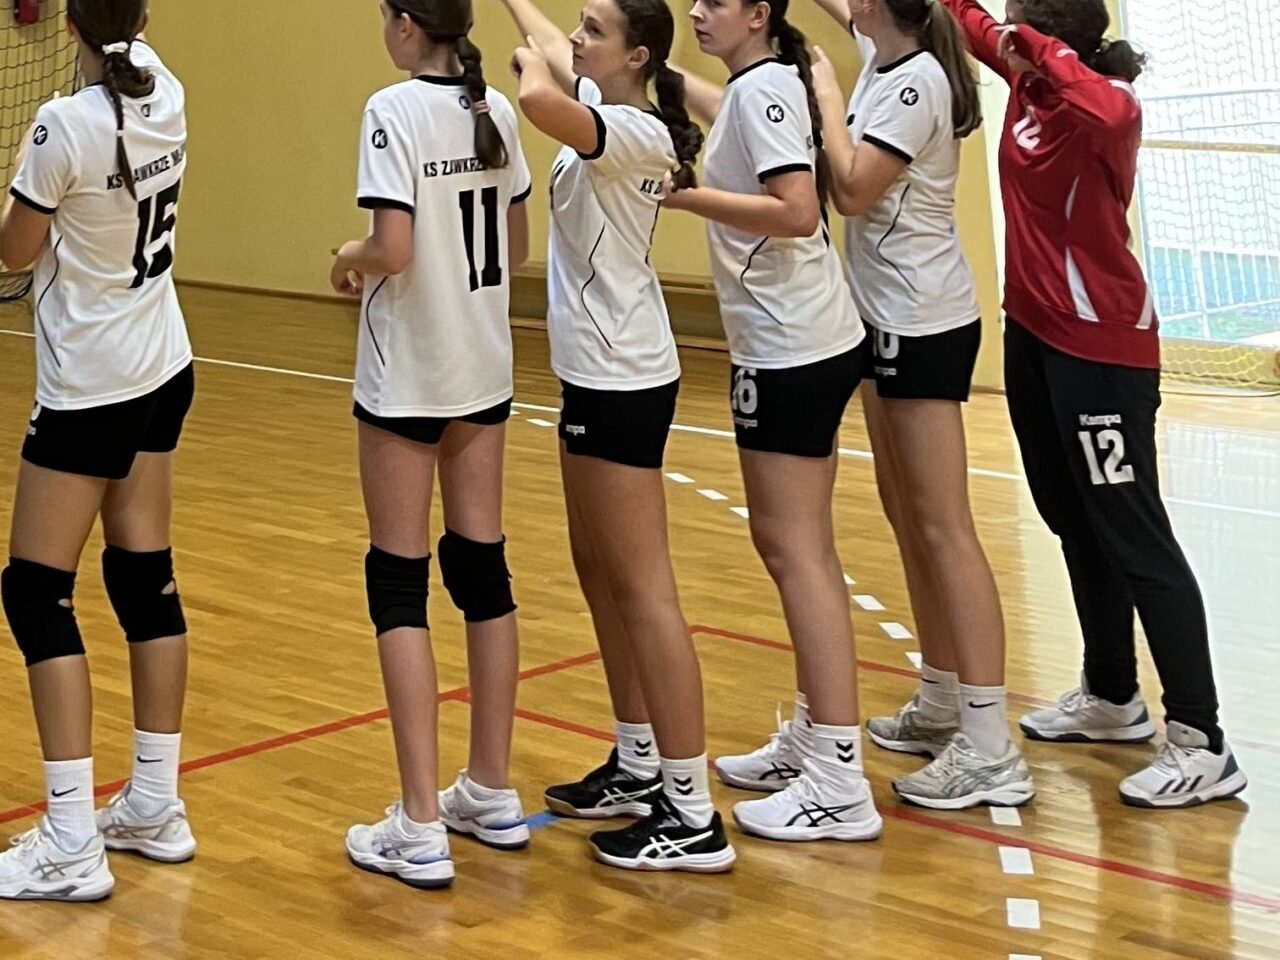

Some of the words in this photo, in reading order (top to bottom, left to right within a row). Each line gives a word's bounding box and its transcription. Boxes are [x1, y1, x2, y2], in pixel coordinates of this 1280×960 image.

[423, 161, 438, 178] KS
[129, 178, 181, 289] 15
[459, 186, 502, 293] 11
[1077, 429, 1136, 486] 12
